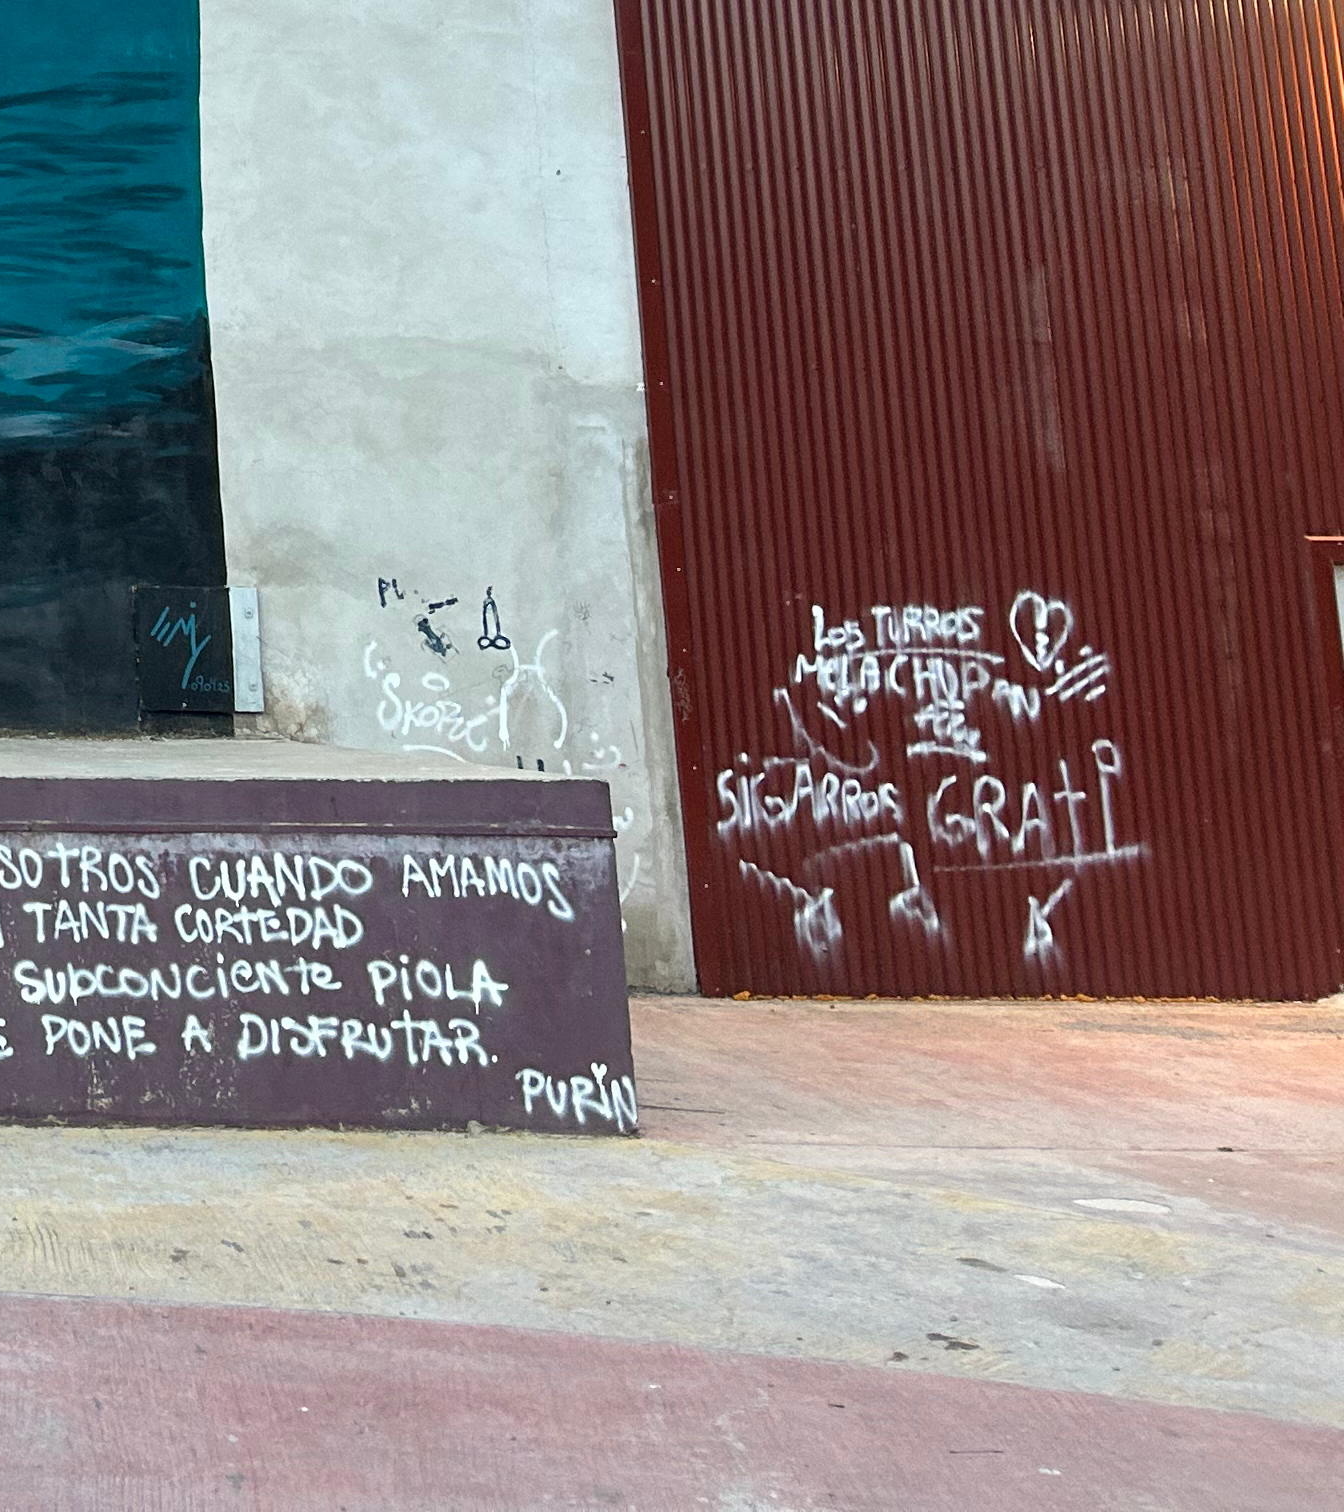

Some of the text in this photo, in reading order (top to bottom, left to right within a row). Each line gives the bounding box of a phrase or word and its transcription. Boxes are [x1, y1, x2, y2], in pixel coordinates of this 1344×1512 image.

[189, 851, 373, 908] CUANDO
[402, 853, 575, 923] AMAMOS
[23, 901, 158, 944] TANTA
[41, 1014, 155, 1060] PONE
[182, 1014, 212, 1052] A
